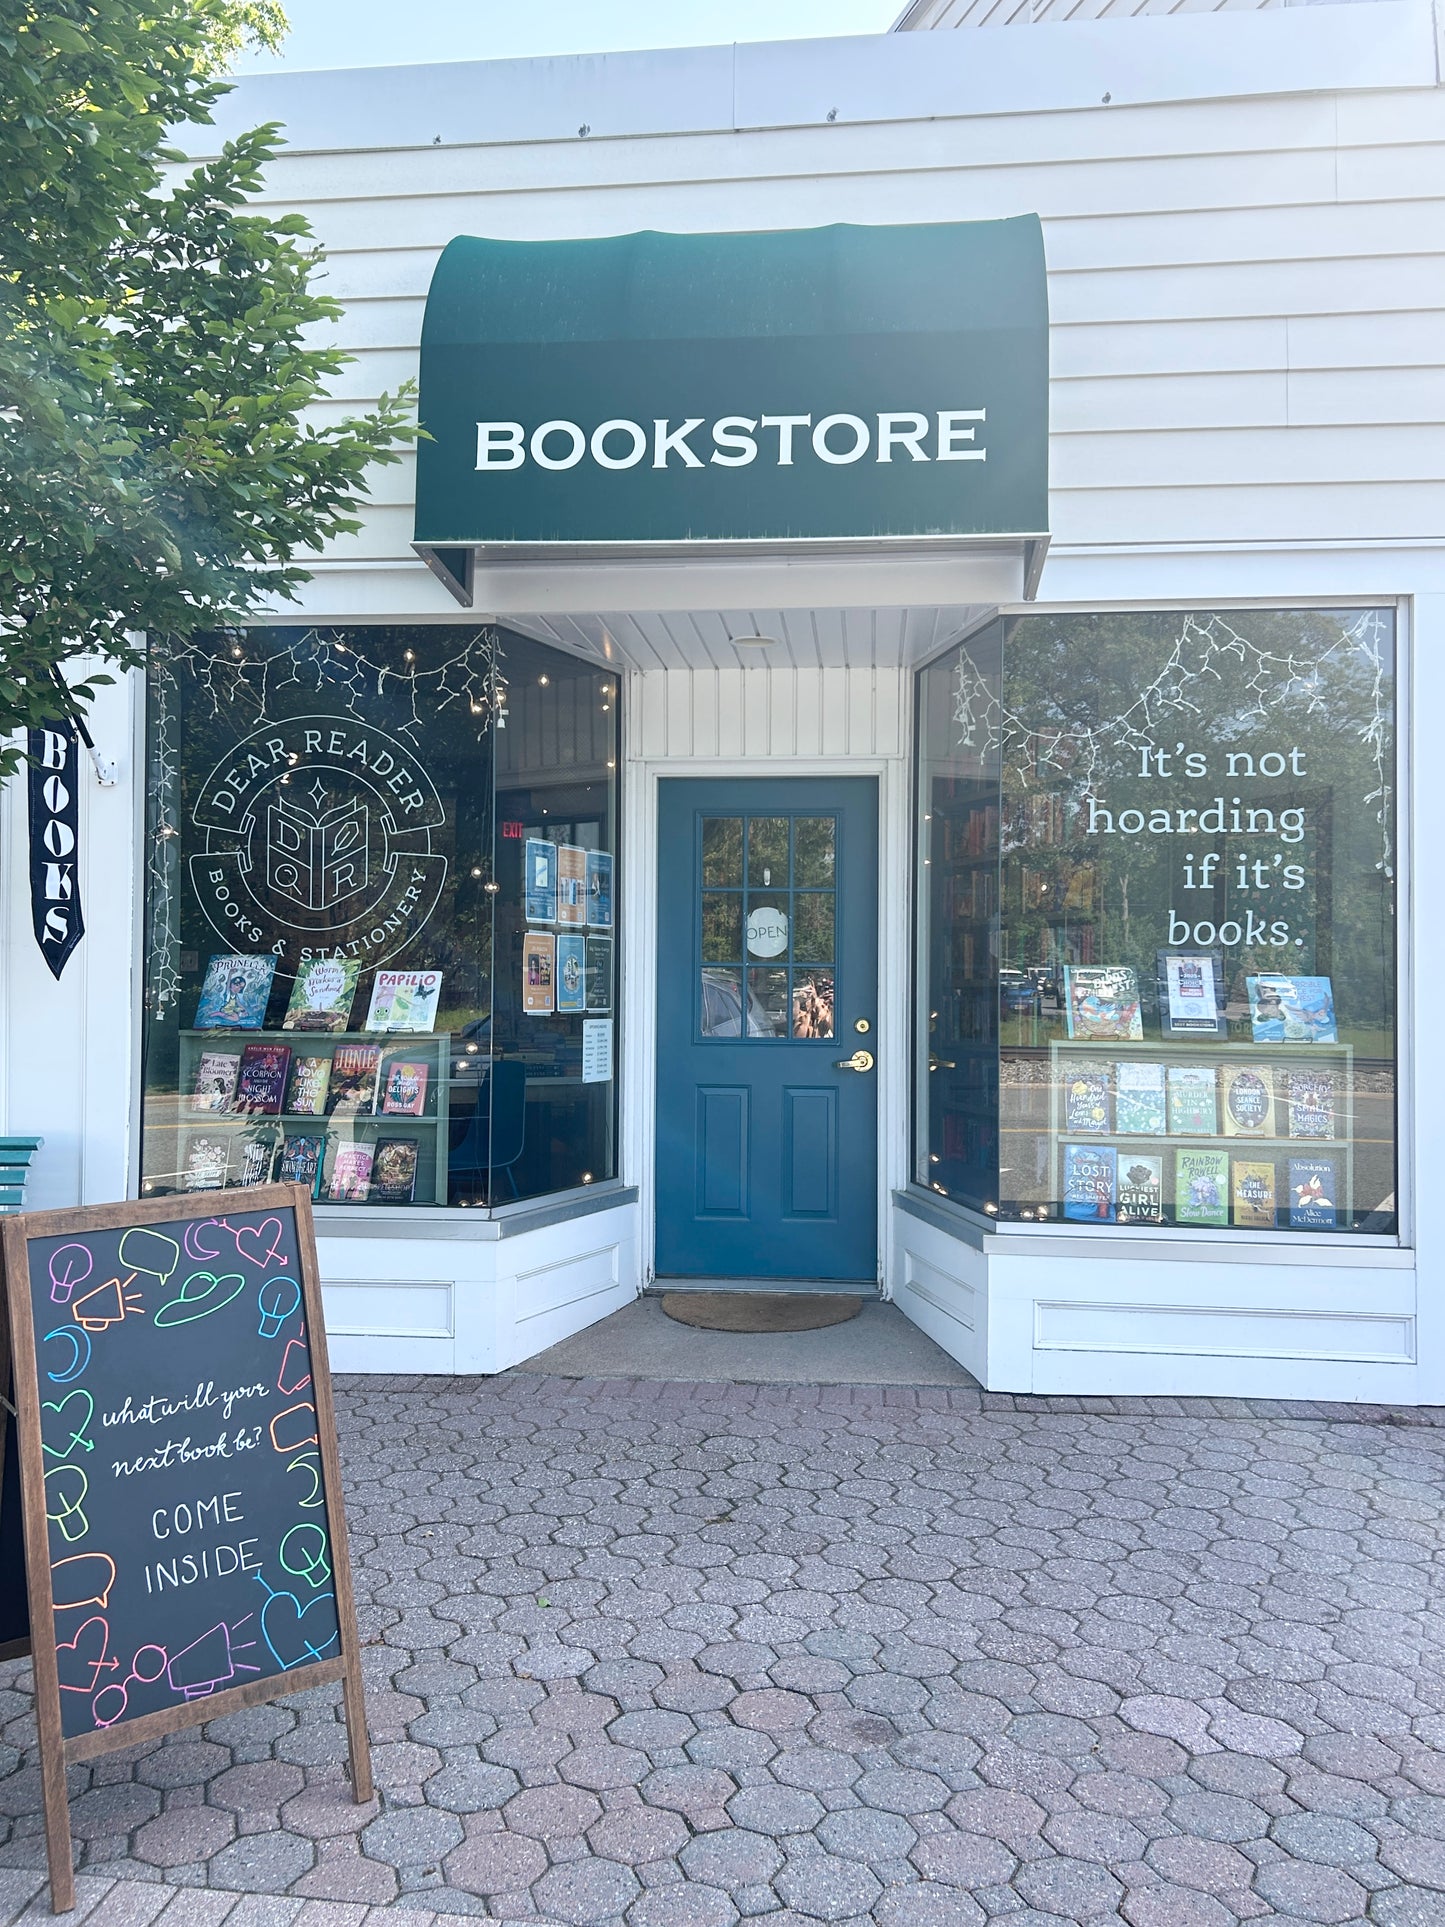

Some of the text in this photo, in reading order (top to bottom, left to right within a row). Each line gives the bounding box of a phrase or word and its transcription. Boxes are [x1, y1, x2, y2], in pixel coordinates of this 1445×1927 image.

[474, 407, 988, 471] BOOKSTORE
[1137, 742, 1307, 778] It's not
[211, 729, 425, 815] DEAR READER
[1086, 797, 1305, 843] hoarding
[40, 728, 75, 945] BOOKS
[503, 822, 523, 838] EXIT
[1183, 853, 1306, 890] if it's
[208, 868, 427, 962] BOOKS & STATIONERY
[746, 925, 787, 940] OPEN
[1168, 909, 1304, 946] books.
[211, 1059, 228, 1068] Late
[310, 1059, 317, 1068] A
[336, 1048, 376, 1070] JUNIE
[202, 1066, 234, 1077] Bloomer
[242, 1070, 282, 1079] SCORPION
[247, 1084, 271, 1093] NIGHT
[388, 1085, 419, 1095] DELIGHTS
[238, 1093, 277, 1103] BLOSSOM
[297, 1098, 316, 1108] SUN
[1235, 1104, 1262, 1112] SOCIETY
[1296, 1104, 1326, 1112] SMALL
[1297, 1113, 1328, 1123] MAGICS
[1181, 1155, 1223, 1169] RAINBOW
[1293, 1162, 1331, 1172] Absolution
[1073, 1164, 1110, 1177] LOST
[1187, 1166, 1220, 1179] ROWELL
[1068, 1179, 1113, 1193] STORY
[1249, 1181, 1261, 1189] THE
[1120, 1192, 1159, 1206] GIRL
[1236, 1189, 1272, 1199] MEASURE
[1120, 1205, 1159, 1217] ALIVE
[1180, 1205, 1224, 1217] Slow Dance
[1304, 1208, 1321, 1217] Alice
[1292, 1216, 1333, 1225] McDermott
[103, 1381, 270, 1427] what will your
[111, 1426, 263, 1477] next book be?
[152, 1491, 245, 1539] COME
[144, 1538, 264, 1594] INSIDE
